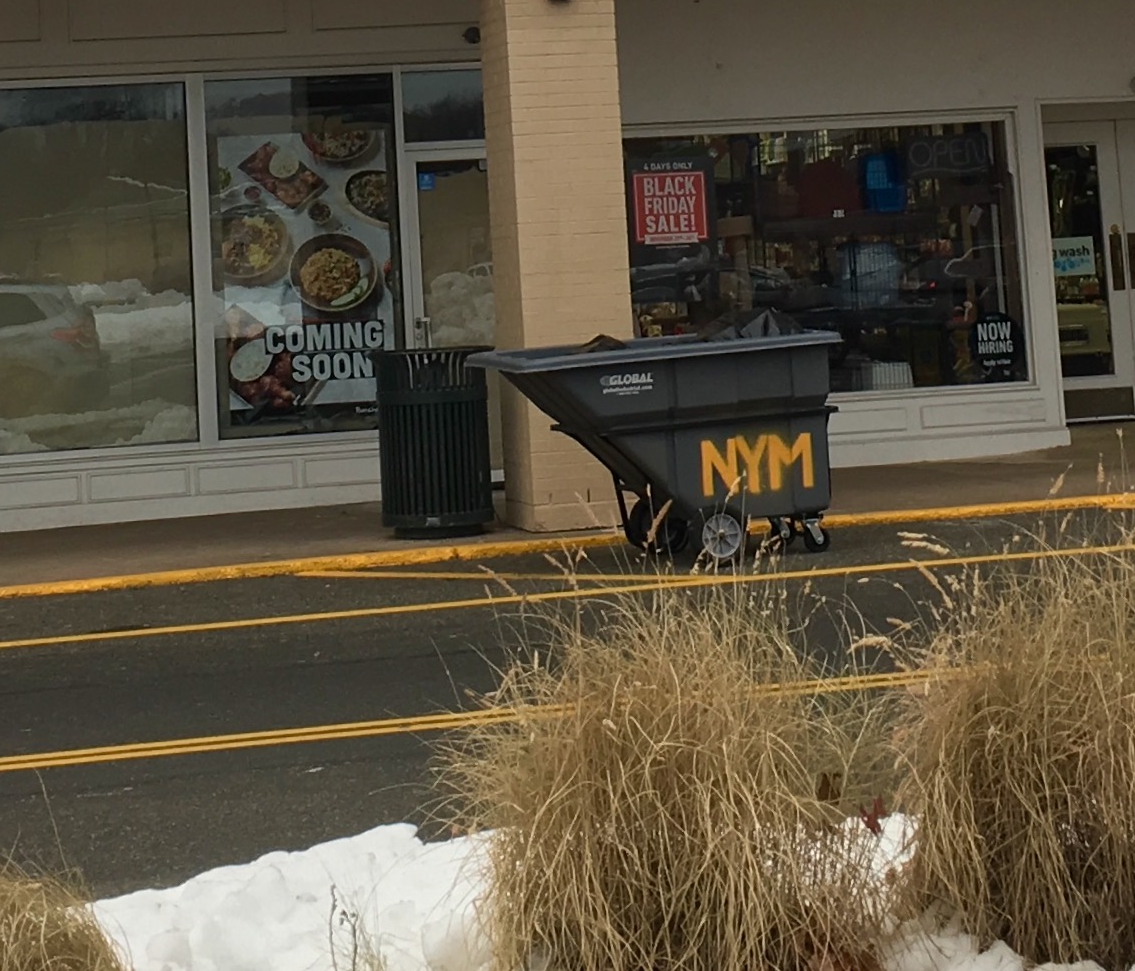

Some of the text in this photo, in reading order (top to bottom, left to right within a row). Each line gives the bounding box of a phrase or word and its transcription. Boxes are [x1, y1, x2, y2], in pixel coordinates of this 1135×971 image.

[909, 137, 987, 169] OPEN
[650, 161, 671, 171] DAYS
[672, 161, 694, 170] ONLY
[643, 175, 697, 197] BLACK
[644, 195, 697, 215] FRIDAY
[645, 214, 697, 234] SALE!
[1058, 244, 1091, 258] wash
[265, 320, 384, 355] COMING
[976, 321, 1012, 342] NOW
[977, 339, 1015, 355] HIRING
[291, 351, 374, 383] SOON
[608, 372, 654, 386] GLOBAL
[700, 432, 815, 498] NYM
